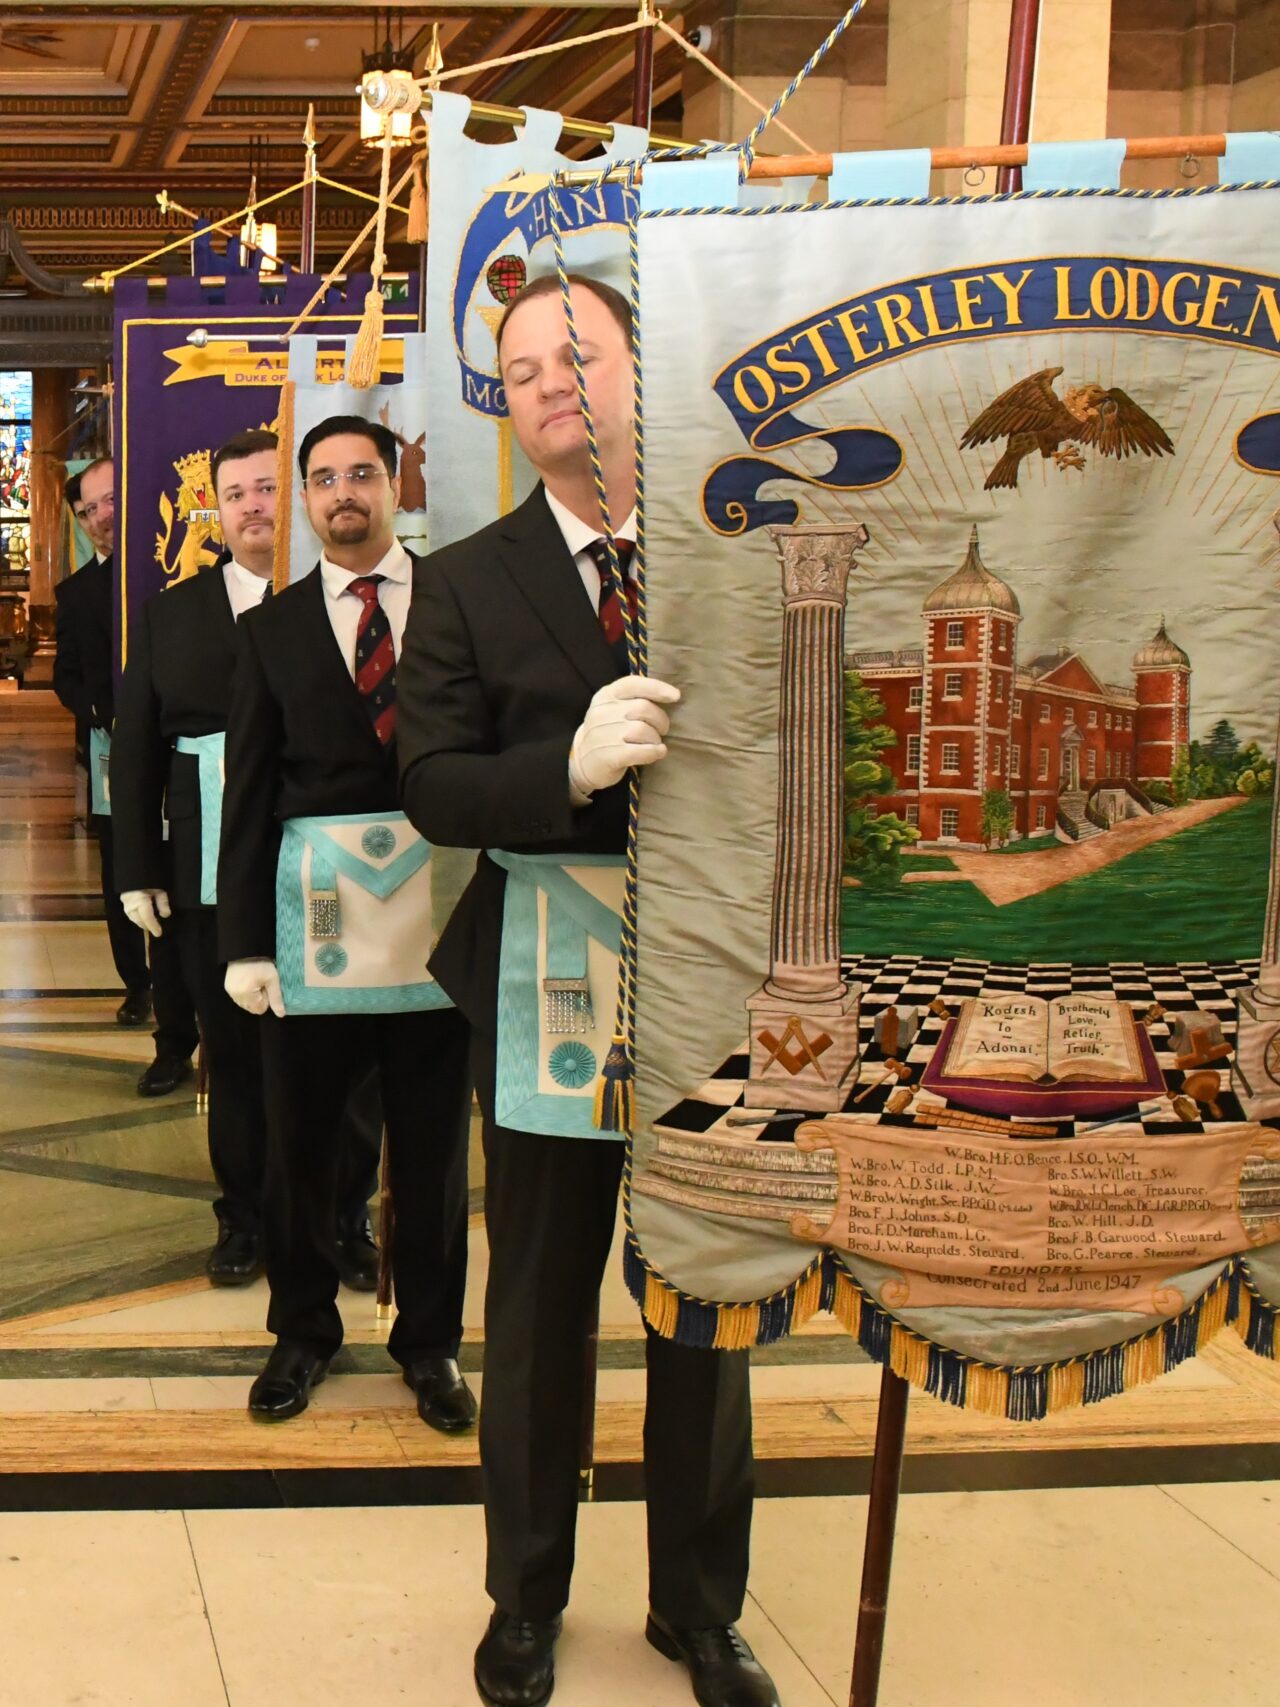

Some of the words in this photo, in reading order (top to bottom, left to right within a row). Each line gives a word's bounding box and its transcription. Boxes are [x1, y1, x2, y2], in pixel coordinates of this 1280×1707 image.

[732, 268, 1035, 414] OSTERLEY
[255, 357, 345, 370] ALERT
[989, 1264, 1082, 1275] FOUNDERS
[1104, 1273, 1142, 1291] 1947
